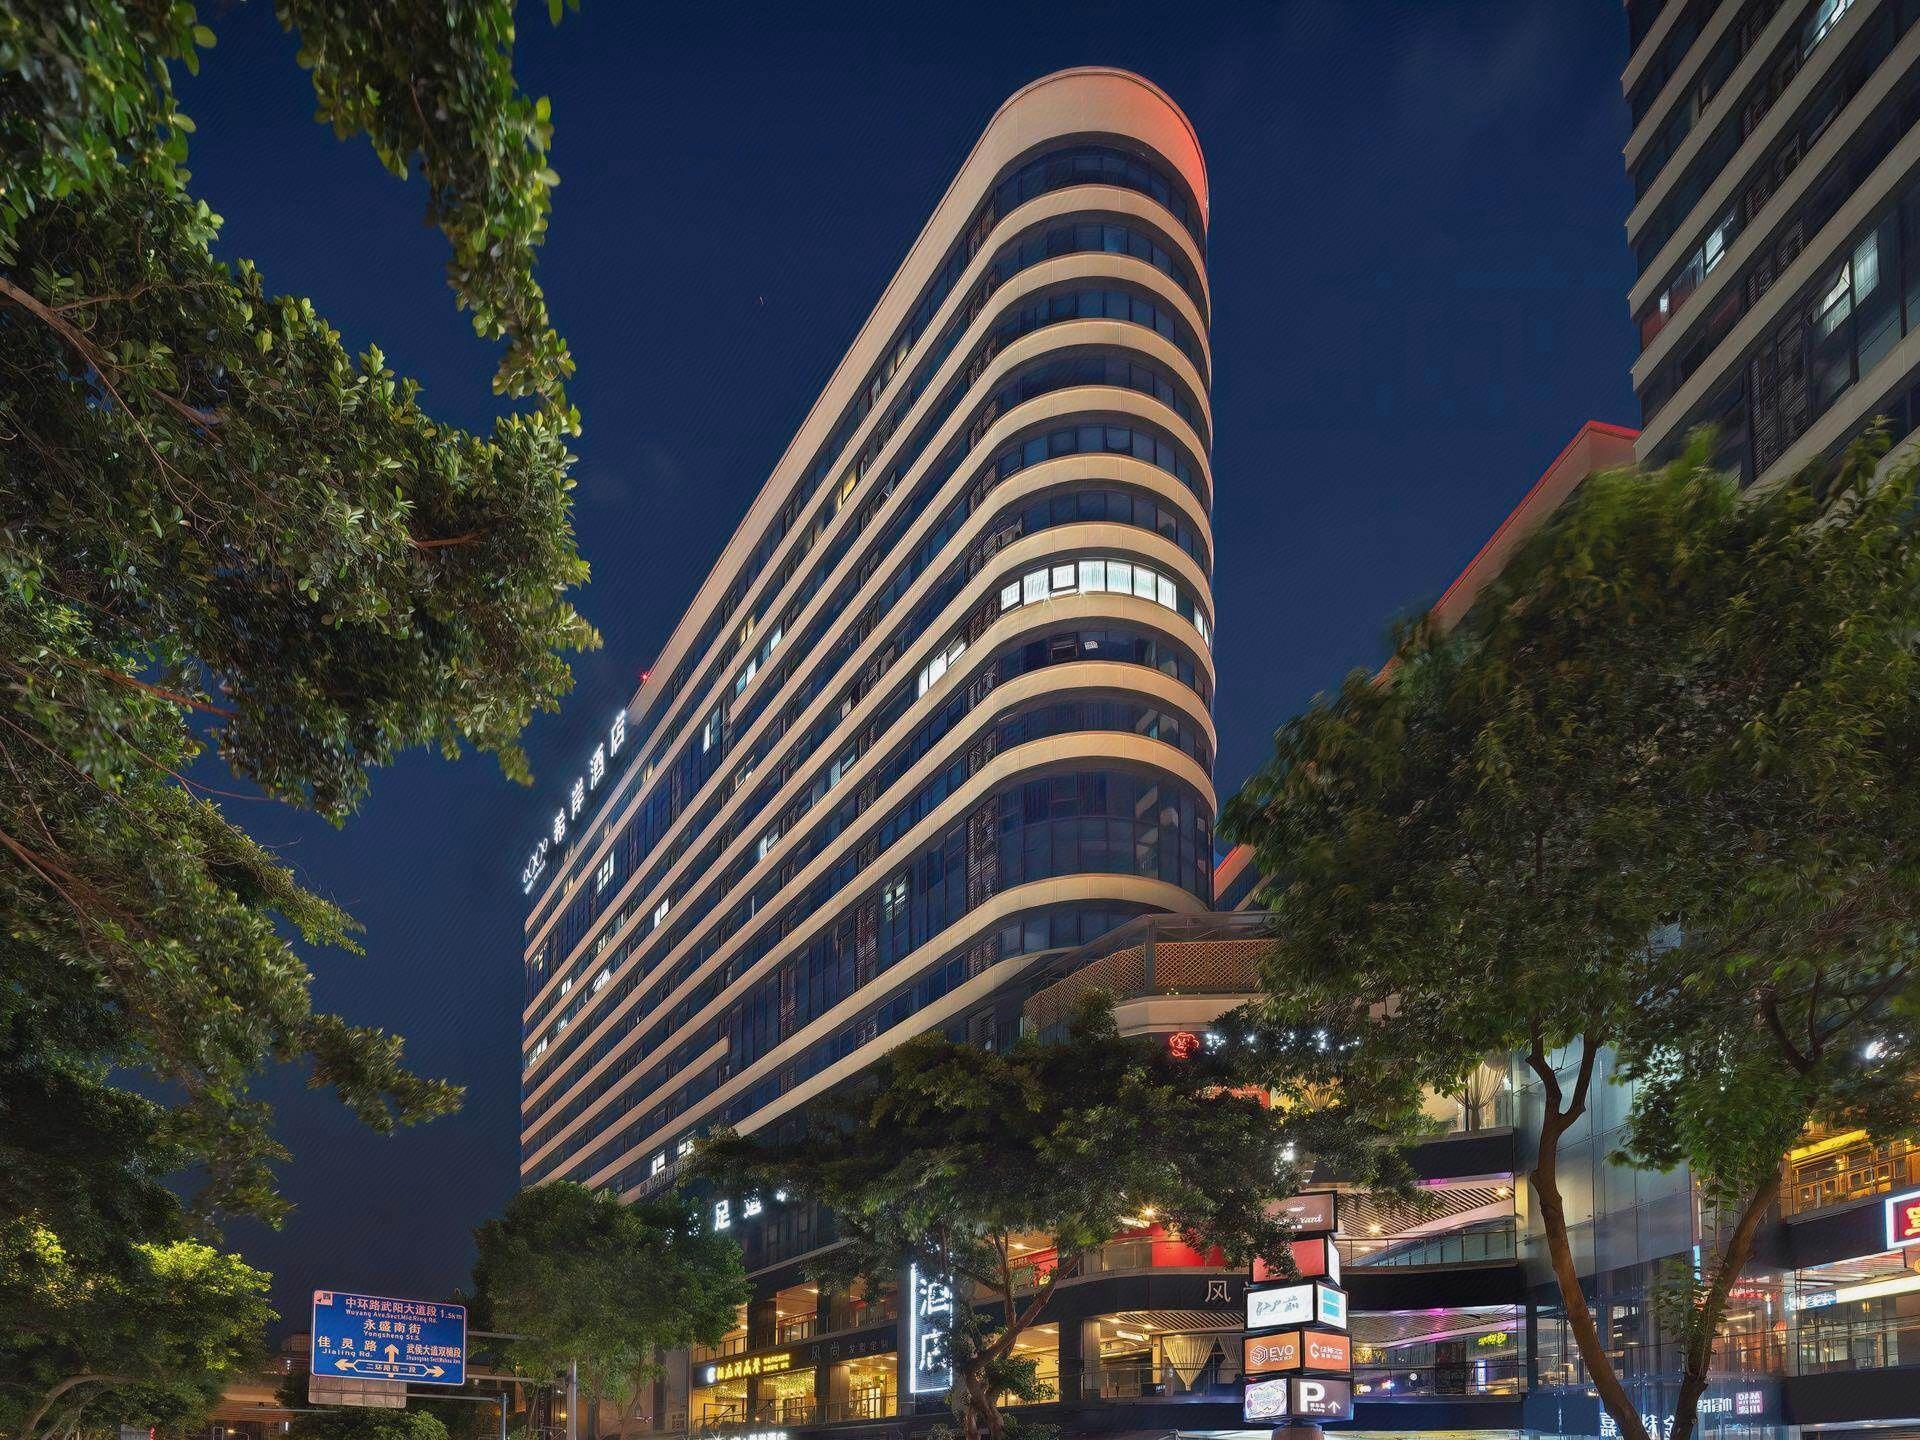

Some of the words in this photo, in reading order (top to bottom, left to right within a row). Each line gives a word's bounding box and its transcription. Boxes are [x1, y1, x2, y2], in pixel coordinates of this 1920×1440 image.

[345, 1297, 437, 1317] 中环路武阳大道段
[363, 1318, 422, 1335] 永盛南街
[317, 1335, 377, 1352] 佳灵路
[1269, 1344, 1294, 1357] EVO
[1300, 1381, 1325, 1412] P
